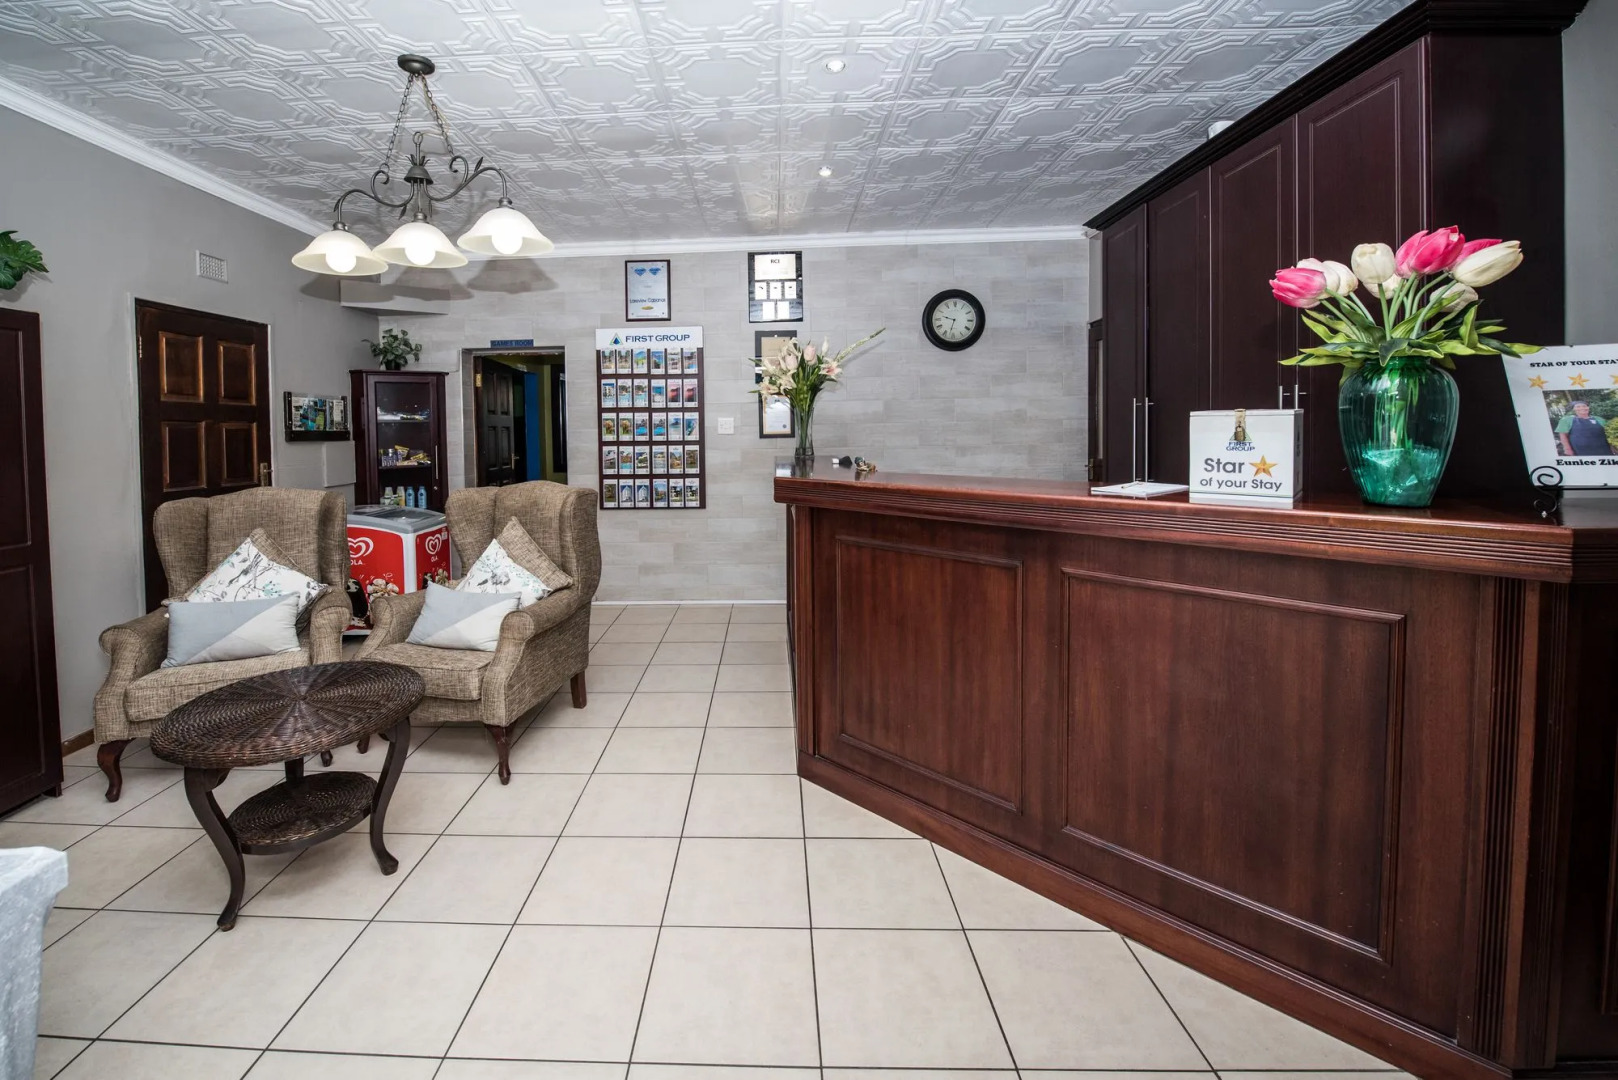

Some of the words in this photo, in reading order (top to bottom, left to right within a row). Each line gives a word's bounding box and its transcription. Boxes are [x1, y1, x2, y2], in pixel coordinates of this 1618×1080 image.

[625, 335, 654, 343] FIRST
[655, 334, 690, 342] GROUP
[1203, 457, 1245, 474] Star
[1555, 458, 1597, 466] Eunice
[1199, 477, 1213, 487] of
[1216, 479, 1247, 489] your
[1251, 478, 1283, 492] Stay
